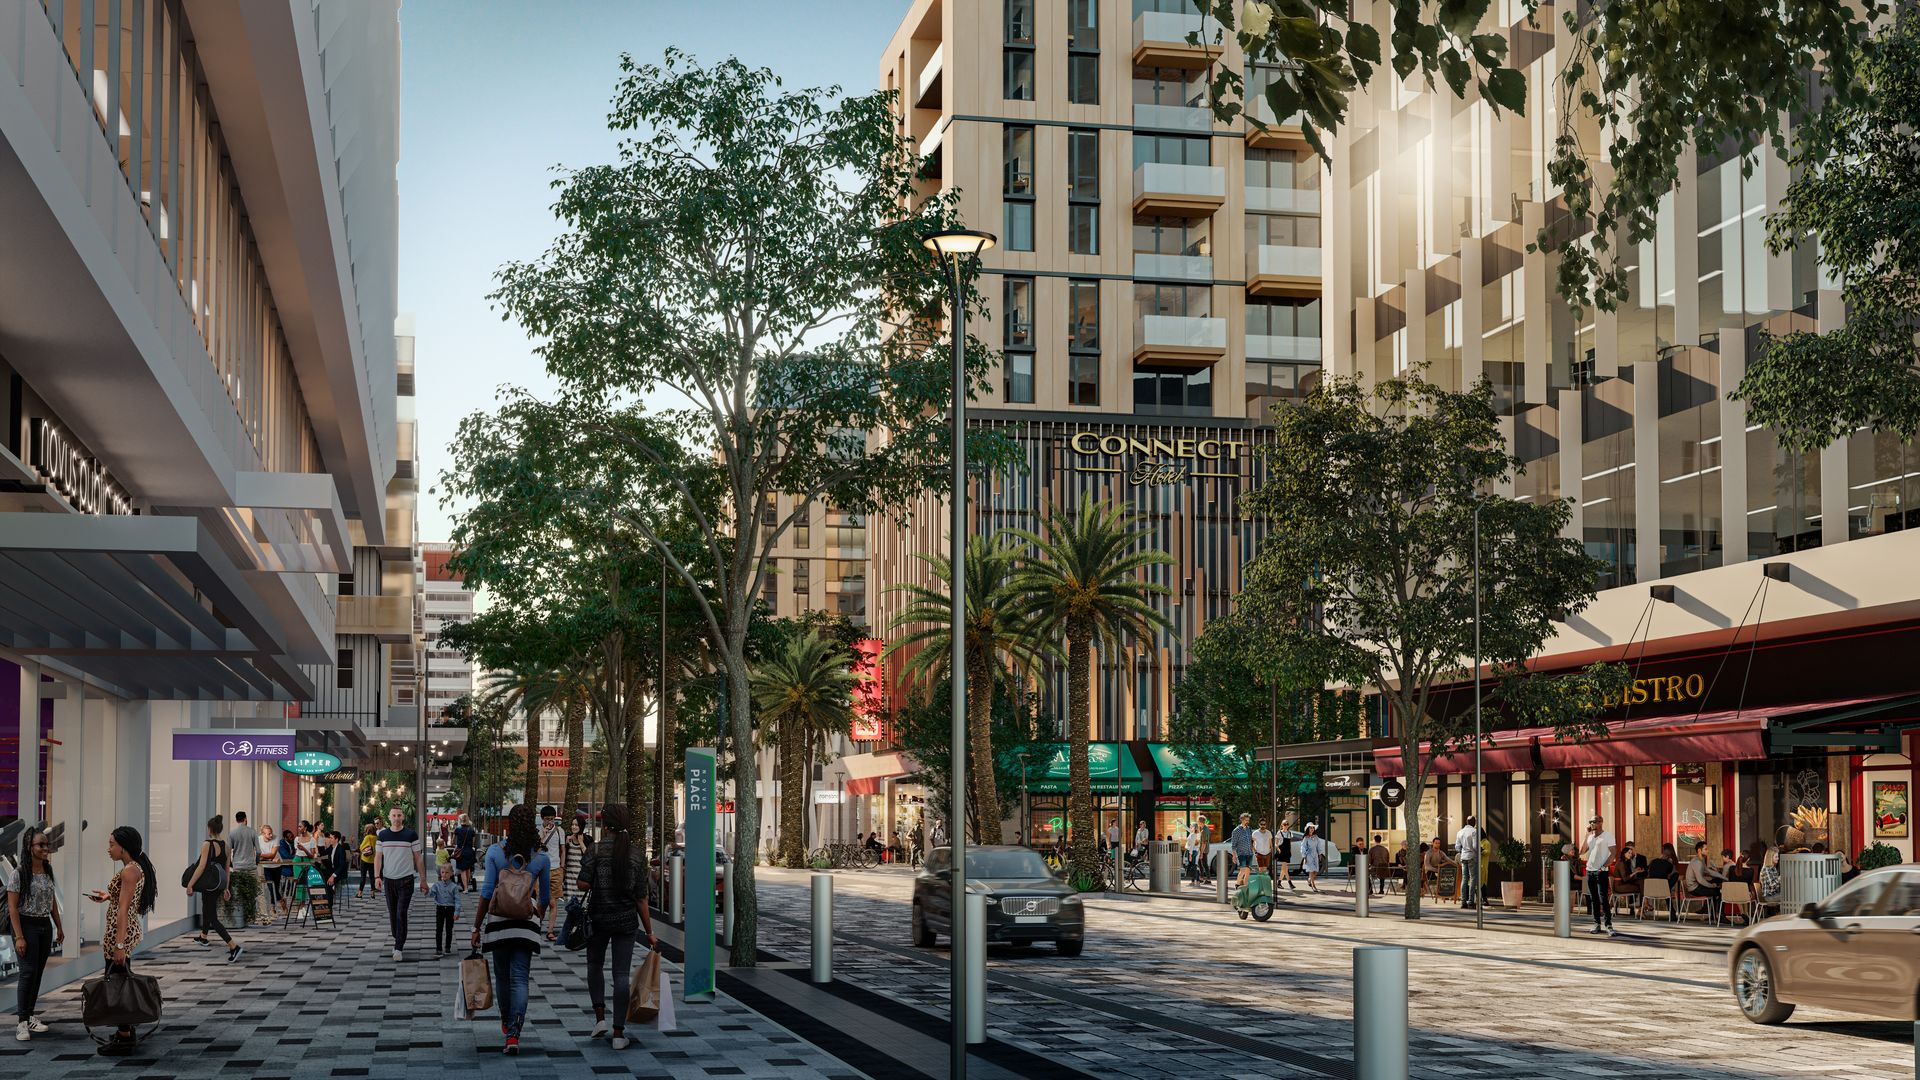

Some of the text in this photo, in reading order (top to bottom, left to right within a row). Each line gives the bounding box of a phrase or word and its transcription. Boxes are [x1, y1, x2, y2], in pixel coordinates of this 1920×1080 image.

[41, 418, 77, 498] novus
[1071, 432, 1245, 460] CONNECT
[1129, 461, 1187, 487] Hotel
[255, 747, 289, 755] FITNESS
[286, 759, 331, 768] CLIPPER
[540, 759, 571, 768] HOME
[690, 769, 701, 811] PLACE
